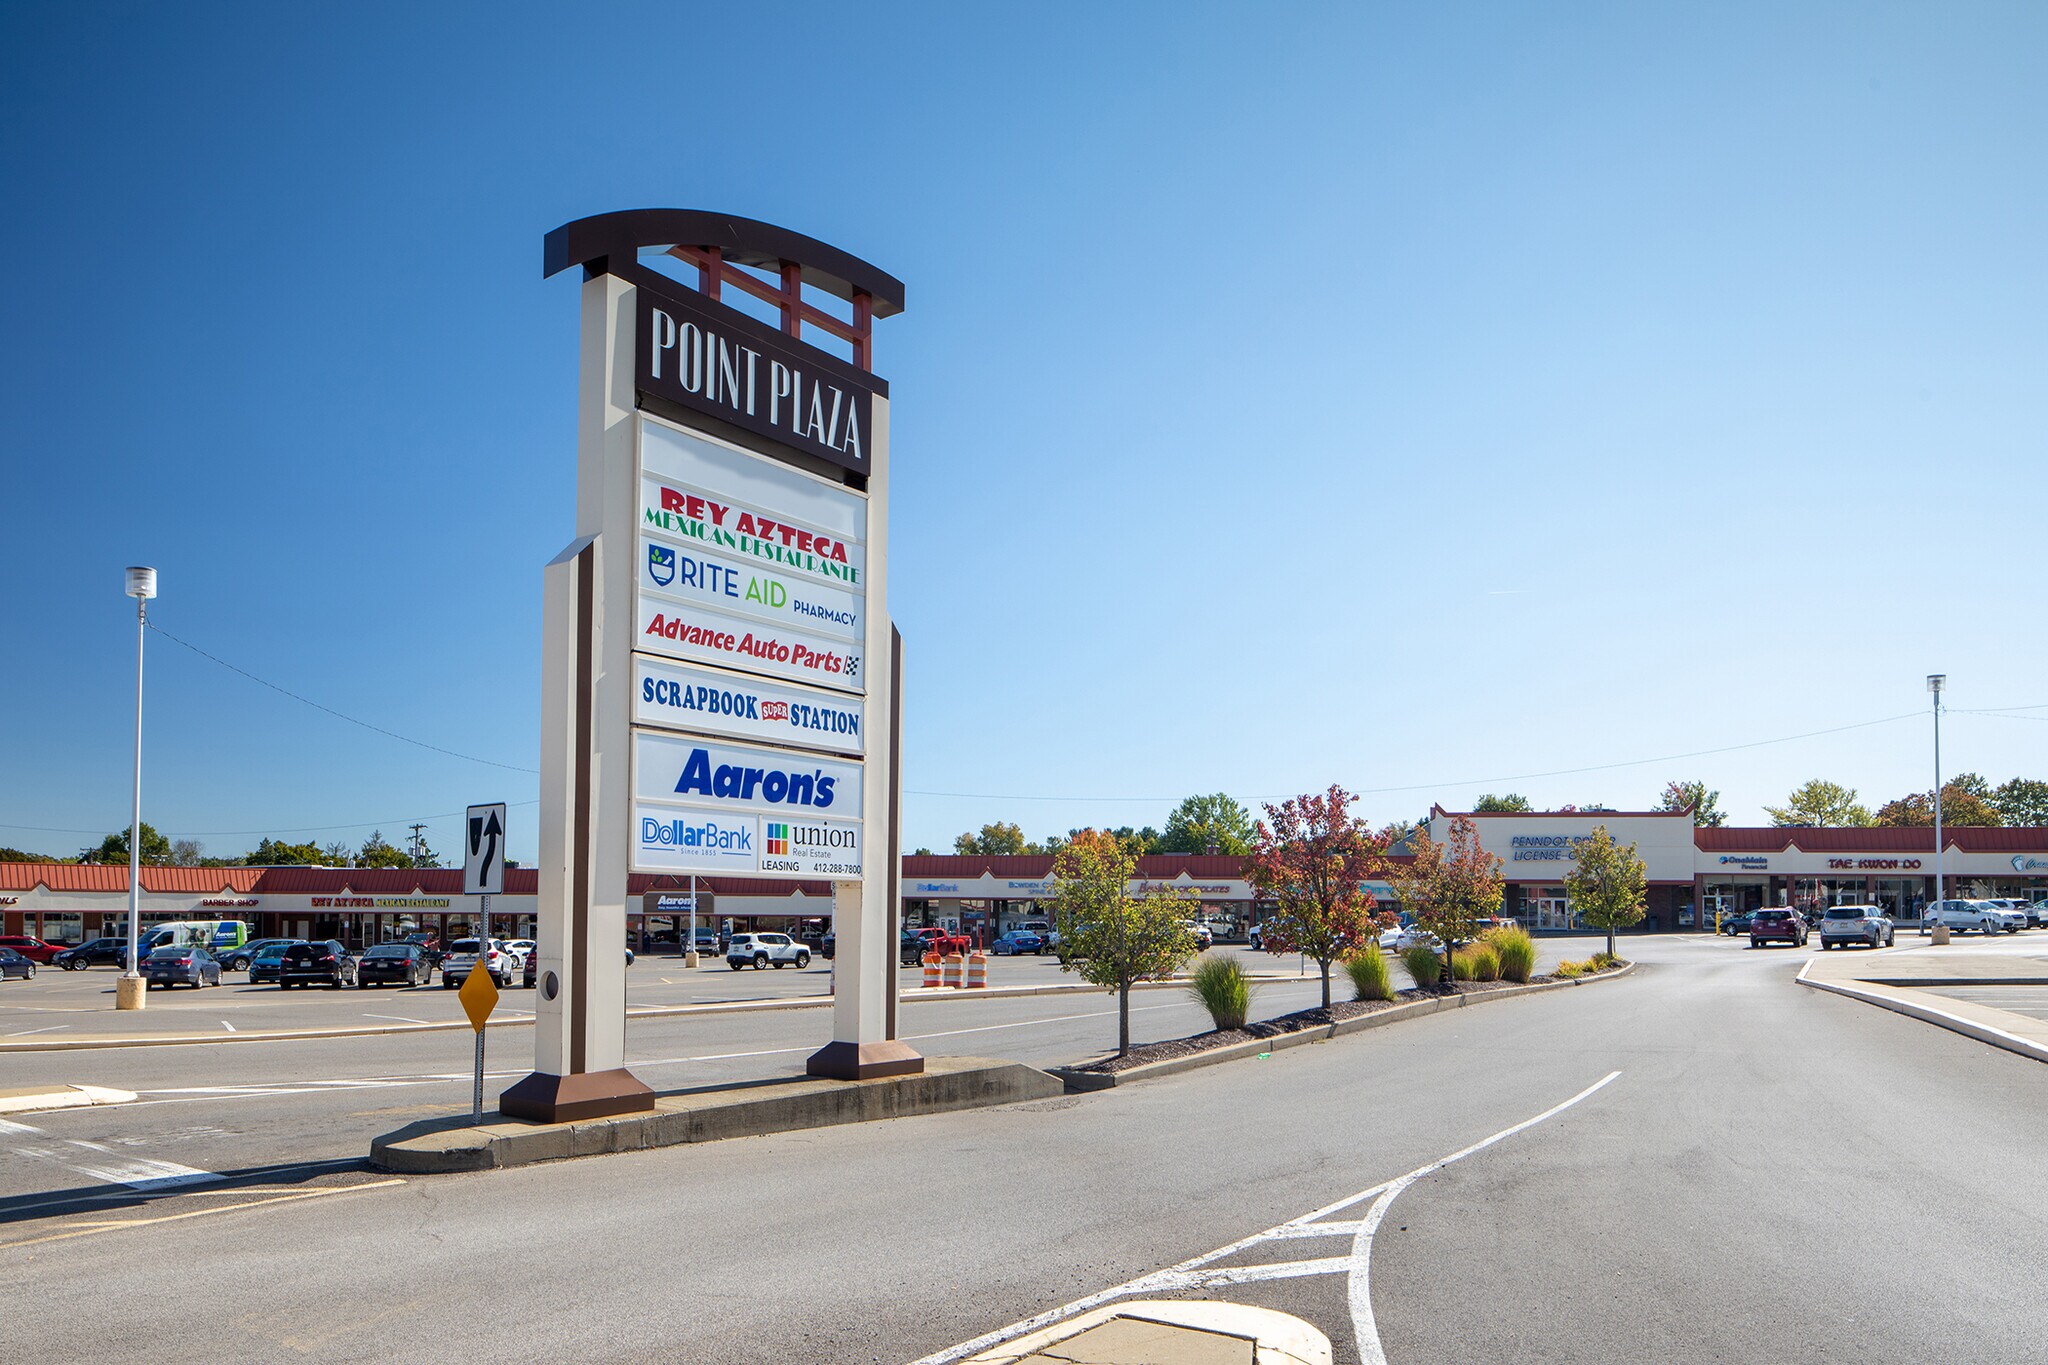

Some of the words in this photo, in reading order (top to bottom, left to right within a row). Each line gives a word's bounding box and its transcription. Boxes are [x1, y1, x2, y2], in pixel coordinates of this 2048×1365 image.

[652, 307, 761, 416] POINT
[770, 360, 862, 459] PLAZA
[660, 486, 730, 526] REY
[736, 512, 848, 564] AZTECA
[644, 507, 736, 549] MEXICAN
[740, 535, 860, 585] RESTAURANTE
[681, 556, 739, 598] RITE
[745, 576, 787, 609] AID
[794, 600, 856, 626] PHARMACY
[646, 613, 735, 651] Advance
[737, 633, 789, 662] Auto
[790, 644, 842, 673] Parts
[643, 677, 758, 720] SCRAPBOOK
[763, 703, 787, 718] SUPER
[791, 704, 859, 736] STATION
[674, 748, 836, 808] Aaron's
[642, 817, 752, 850] DollarBank
[793, 821, 857, 848] union
[1511, 836, 1569, 847] PENNDOT
[681, 848, 698, 856] Since
[702, 848, 717, 857] 1855
[793, 848, 808, 857] Real
[810, 849, 831, 859] Estate
[1514, 851, 1561, 861] LICENSE
[1728, 856, 1768, 864] OneMain
[1828, 859, 1853, 869] TAE
[1858, 859, 1898, 869] KWON
[1903, 859, 1922, 869] DO
[762, 861, 800, 872] LEASING
[814, 863, 861, 875] 412-288-7800
[203, 899, 235, 907] BARBER
[237, 899, 259, 907] SHOP
[311, 898, 333, 907] REY
[334, 898, 375, 907] AZTECA
[376, 898, 407, 908] MEXICAN
